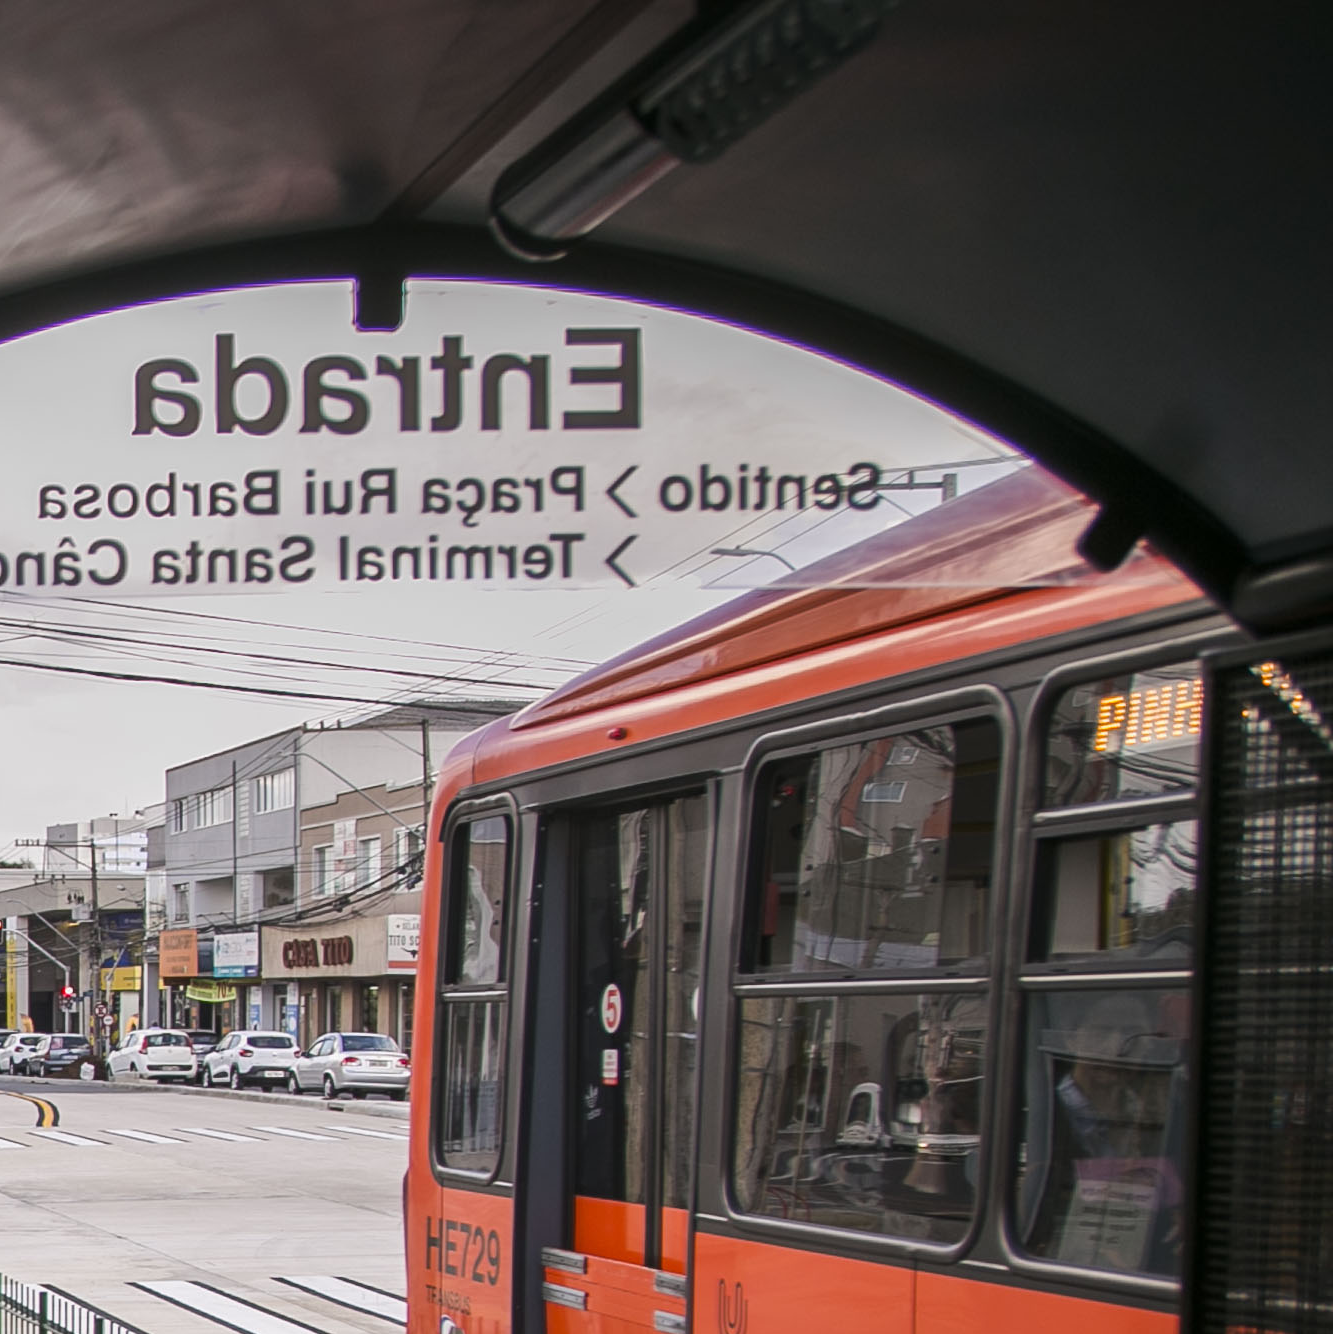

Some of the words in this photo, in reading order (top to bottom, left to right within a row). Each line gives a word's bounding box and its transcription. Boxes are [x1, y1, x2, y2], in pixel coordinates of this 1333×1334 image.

[283, 938, 319, 969] CASA
[321, 935, 354, 966] TITO
[605, 988, 618, 1029] 5
[425, 1215, 501, 1287] HE729
